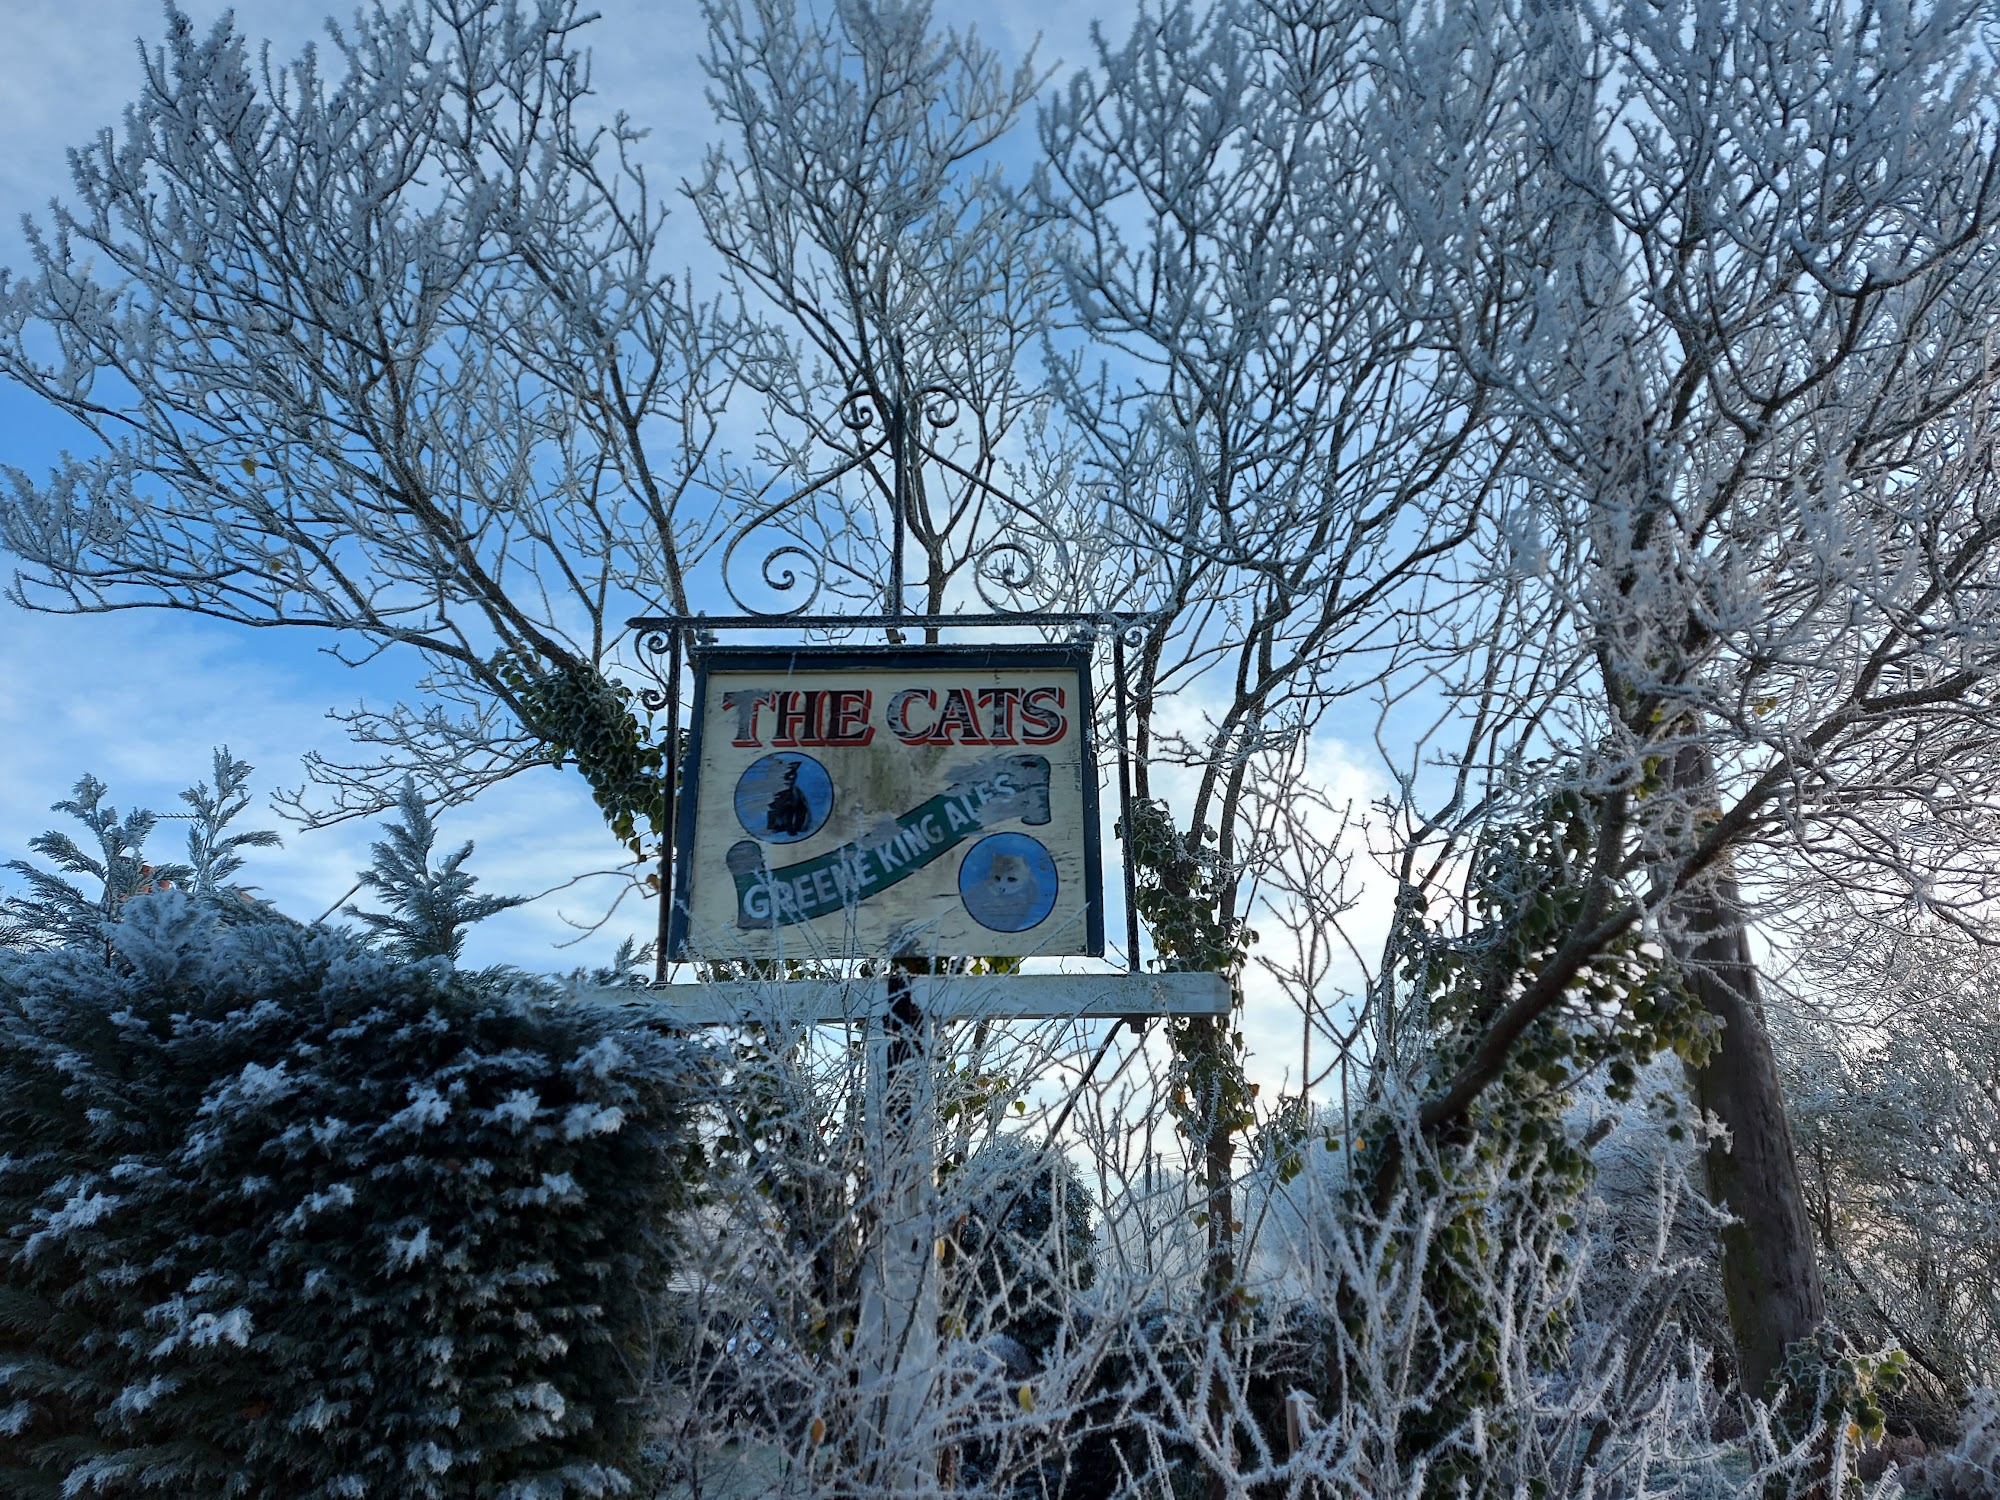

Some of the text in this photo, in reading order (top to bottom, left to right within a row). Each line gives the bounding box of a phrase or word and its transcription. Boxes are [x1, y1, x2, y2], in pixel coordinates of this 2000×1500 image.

[721, 687, 1068, 748] THE CATS
[743, 850, 878, 919] GREENE
[875, 813, 945, 873] KING
